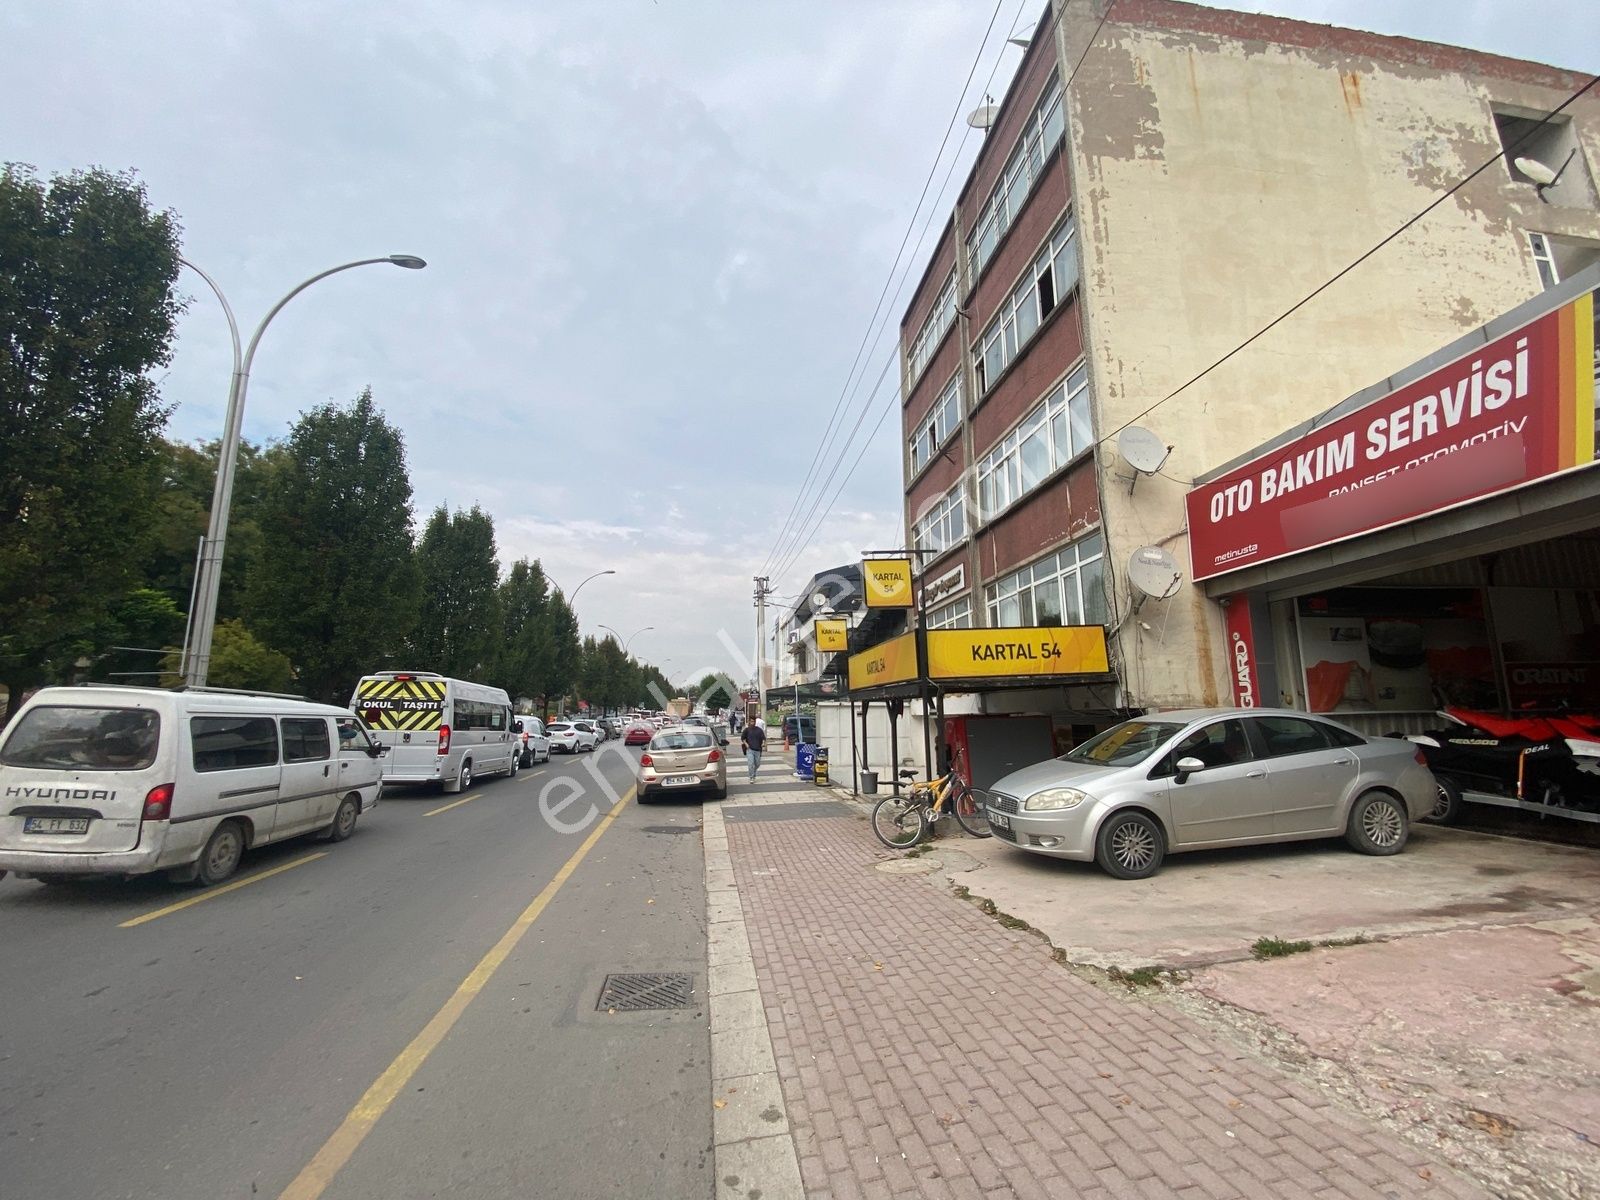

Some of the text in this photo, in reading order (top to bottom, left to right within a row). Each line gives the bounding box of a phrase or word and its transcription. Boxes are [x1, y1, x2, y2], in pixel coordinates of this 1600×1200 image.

[1209, 336, 1529, 524] OTO BAKIM SERVİSİ
[1214, 543, 1259, 563] metinusta
[872, 572, 904, 582] KARTAL
[883, 584, 895, 593] 54
[971, 642, 1062, 661] KARTAL 54
[363, 701, 438, 711] OKUL TAŞITI
[5, 786, 118, 801] HYUNDAI
[31, 819, 42, 830] 54
[50, 820, 62, 830] FY
